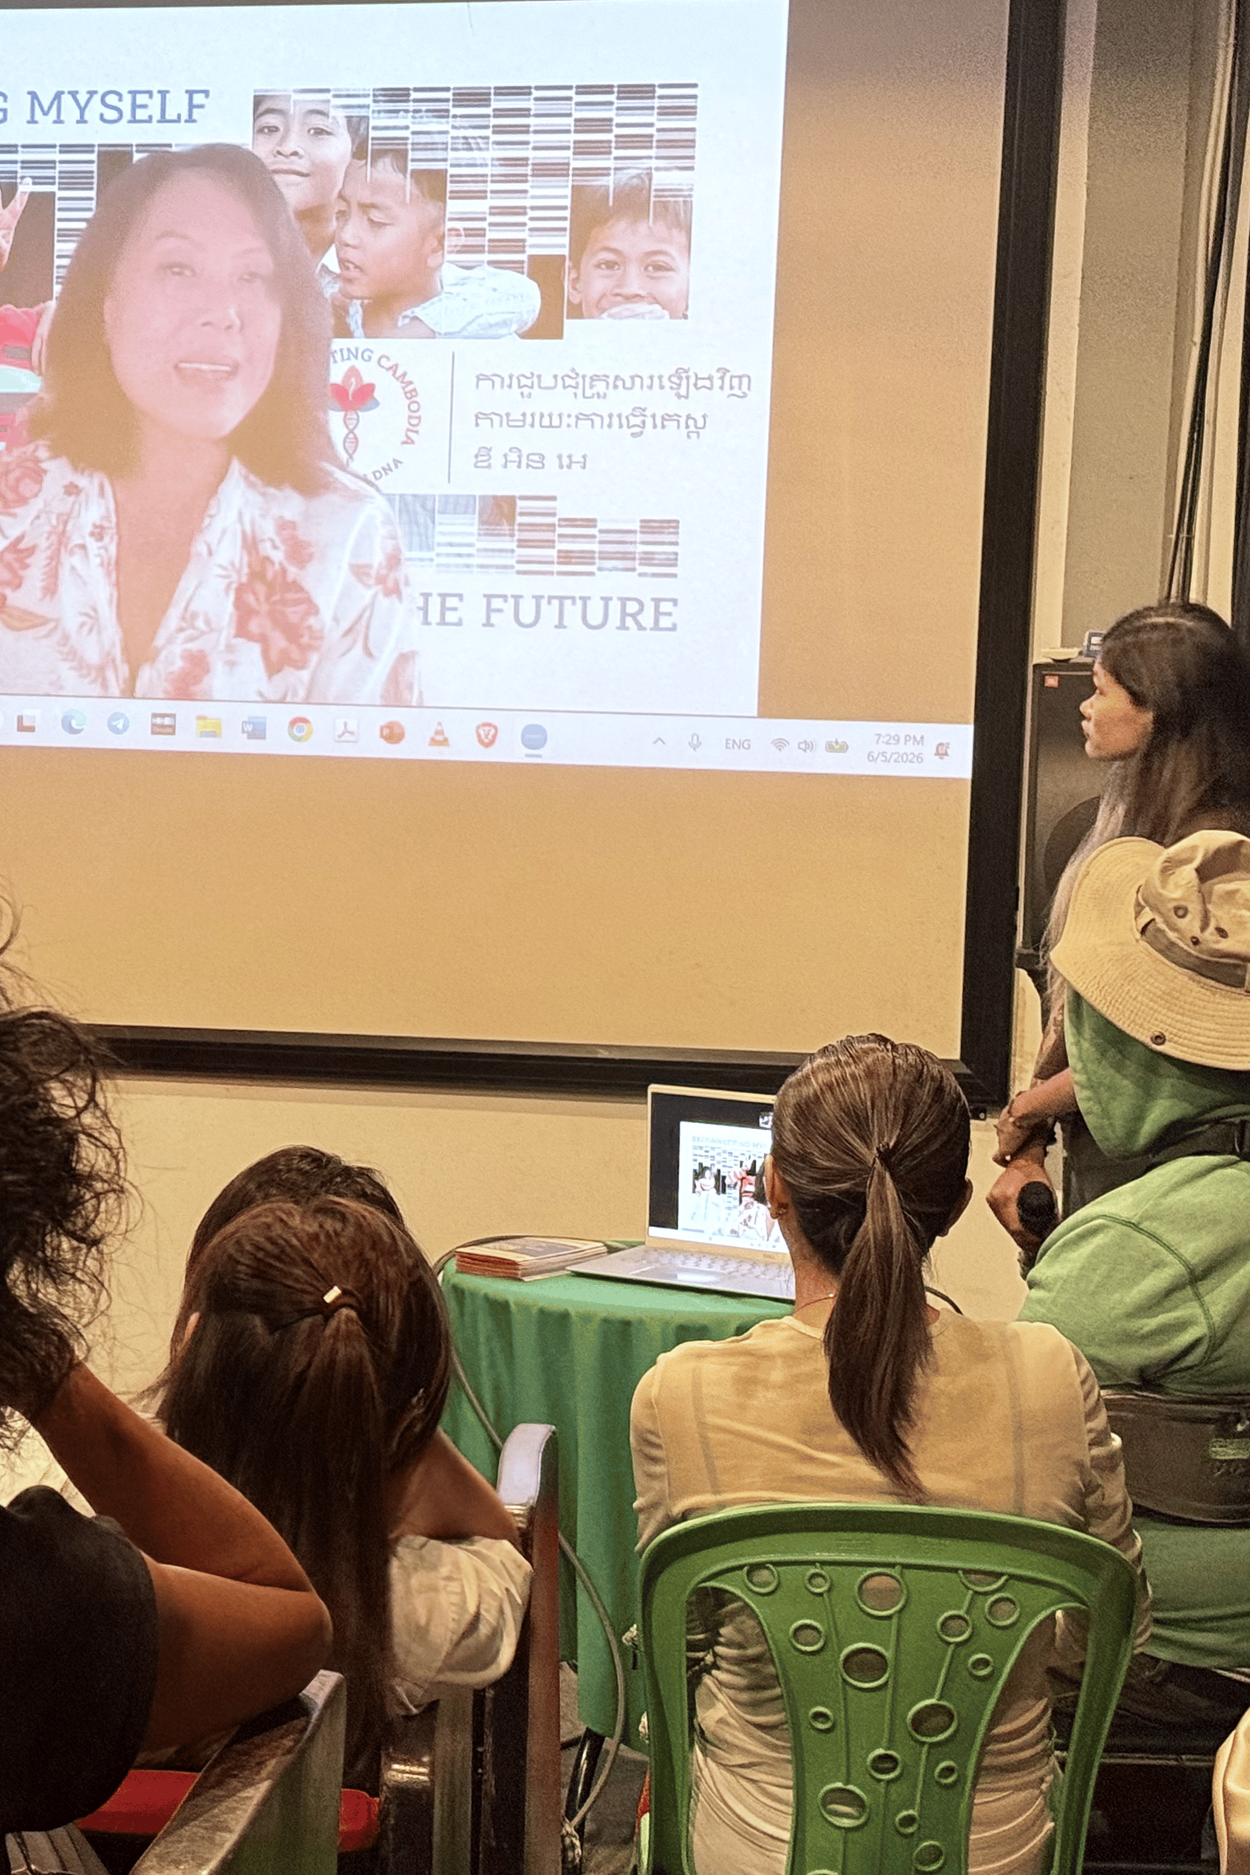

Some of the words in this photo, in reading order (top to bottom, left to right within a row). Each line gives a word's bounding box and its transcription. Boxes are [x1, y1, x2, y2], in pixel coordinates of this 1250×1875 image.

[25, 89, 210, 124] MYSELF
[377, 354, 422, 446] CAMBODIA
[371, 457, 404, 481] DNA
[416, 592, 464, 627] HE
[481, 594, 678, 632] FUTURE
[725, 738, 751, 750] ENG
[874, 733, 901, 746] 7:29
[904, 735, 925, 747] PM
[867, 751, 924, 764] 6/5/2026
